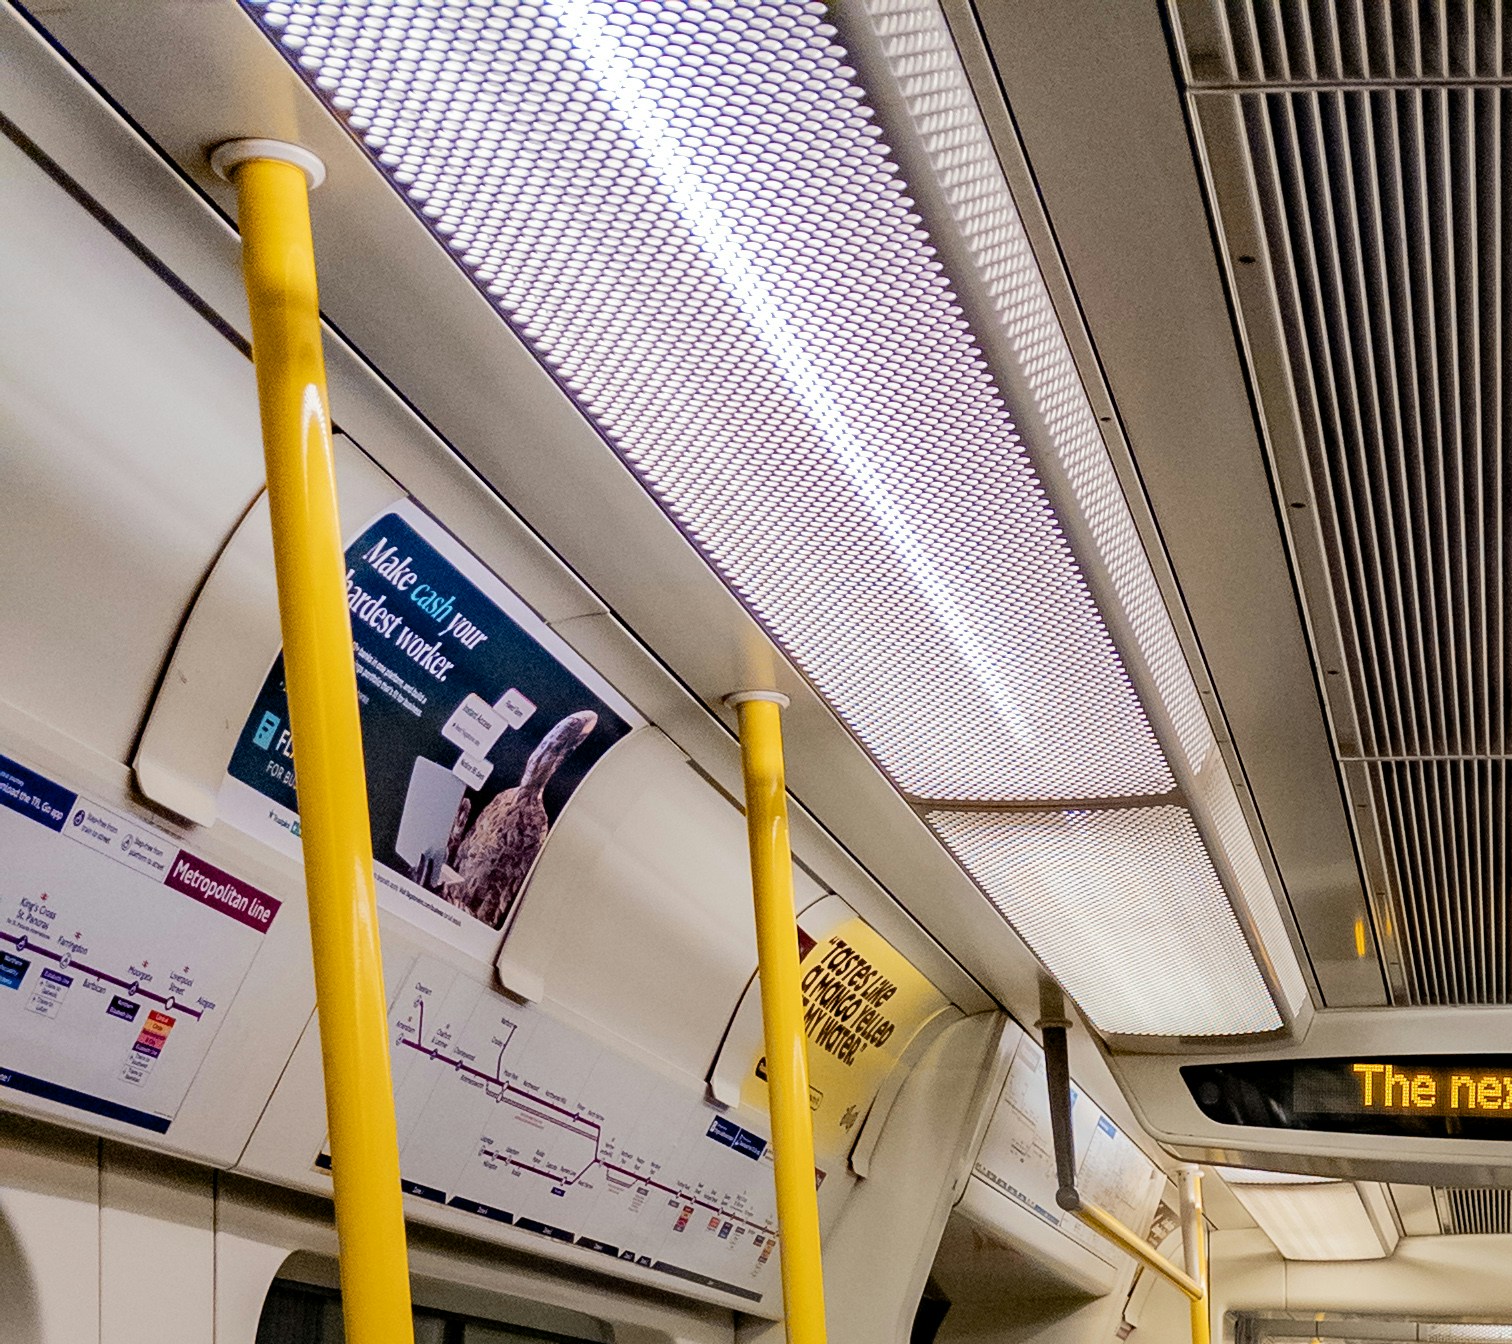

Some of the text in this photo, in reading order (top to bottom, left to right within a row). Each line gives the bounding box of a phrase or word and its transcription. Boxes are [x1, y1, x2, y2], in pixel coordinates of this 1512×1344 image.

[362, 537, 488, 650] Make cash your
[395, 626, 455, 682] worker.
[265, 760, 285, 779] FOR
[173, 859, 272, 924] Metropolitan line
[1353, 1064, 1436, 1108] The
